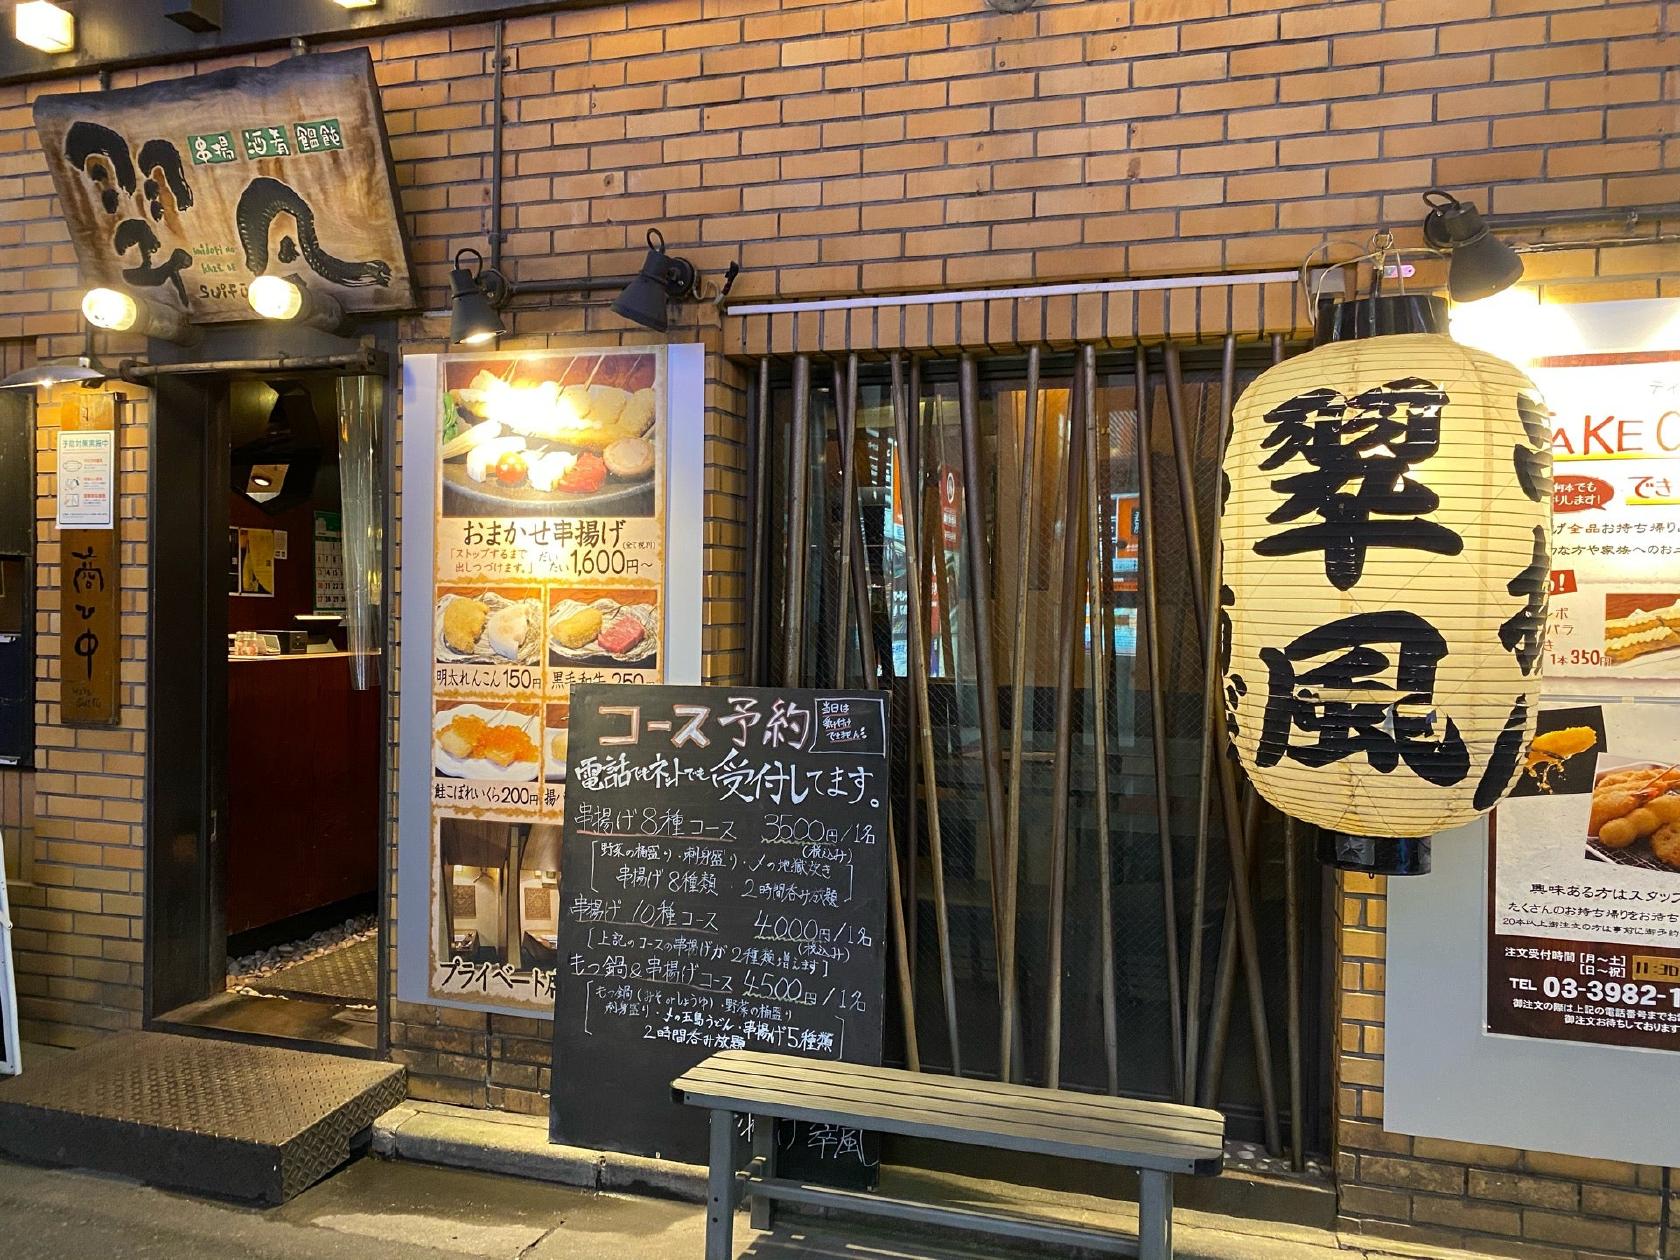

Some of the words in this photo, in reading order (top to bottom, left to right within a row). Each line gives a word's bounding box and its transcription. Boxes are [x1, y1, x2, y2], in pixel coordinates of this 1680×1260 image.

[1548, 412, 1644, 456] AKE
[463, 519, 627, 548] おまかせ串揚げ
[1552, 521, 1680, 535] げ全品お持ち帰り
[612, 672, 655, 685] 250
[821, 701, 850, 714] 当日は
[598, 697, 810, 750] コース予約
[544, 788, 561, 807] 揚
[574, 802, 737, 840] 串揚げ8種コース
[1504, 946, 1576, 963] 注文受付時間
[1508, 977, 1538, 991] TEL
[1543, 976, 1680, 1009] 03-3982-1
[1513, 998, 1680, 1023] 御注文の際は上記の電話番号までお
